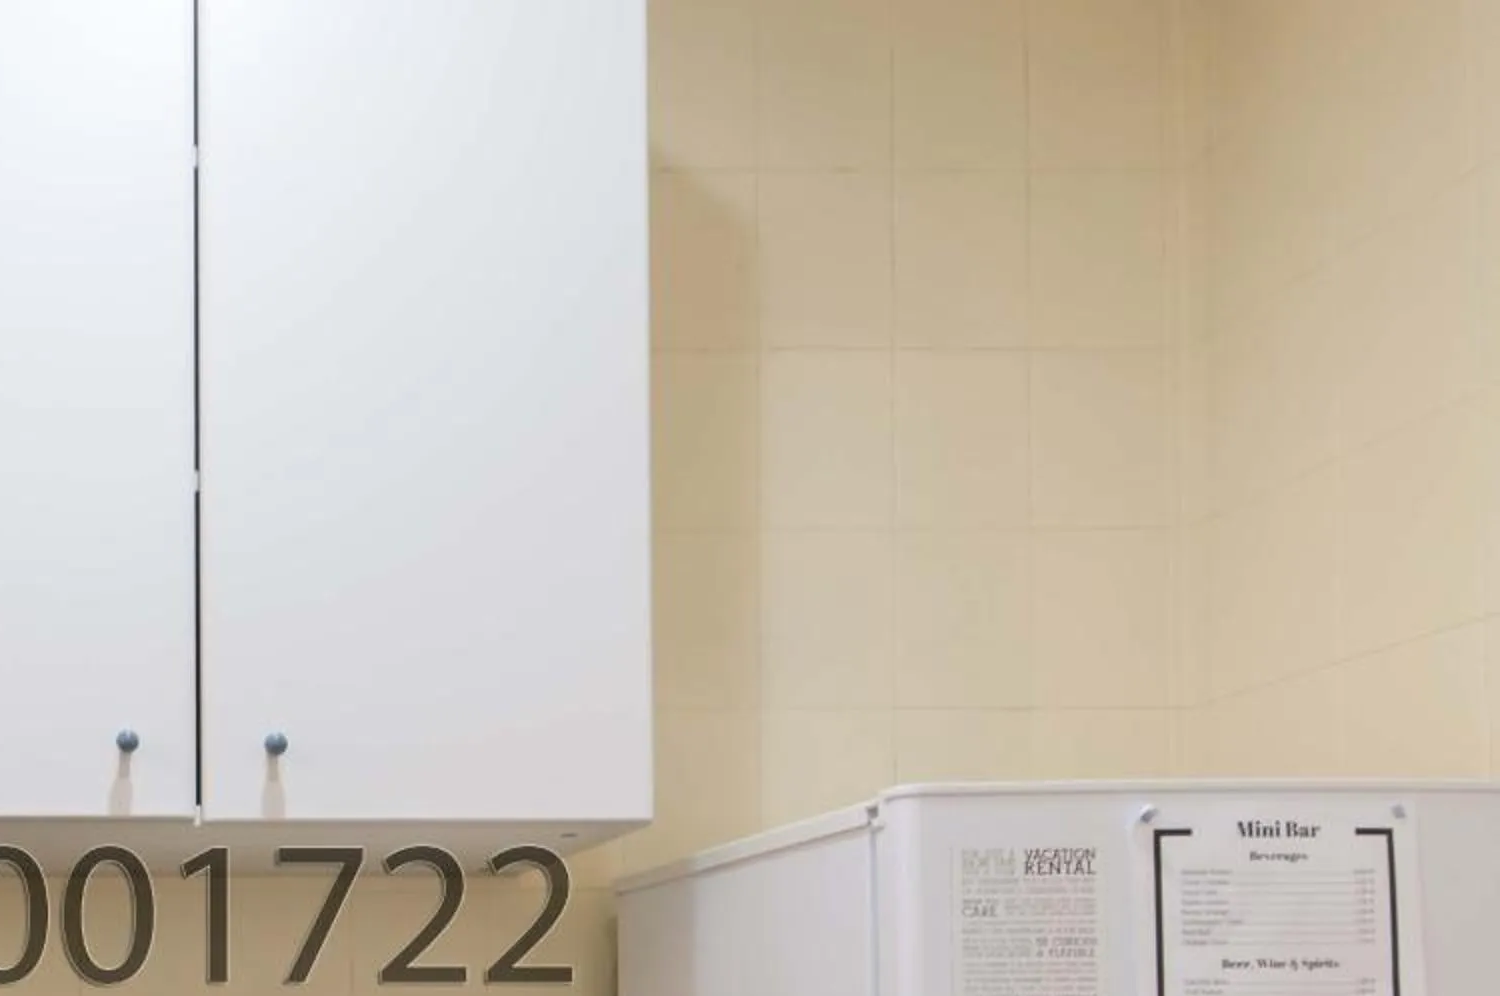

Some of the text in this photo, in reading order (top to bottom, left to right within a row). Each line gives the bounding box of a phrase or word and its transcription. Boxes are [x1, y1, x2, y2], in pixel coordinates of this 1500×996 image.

[1237, 820, 1321, 838] Mini Bar
[1023, 847, 1097, 860] VACATION
[1024, 860, 1097, 875] RENTAL
